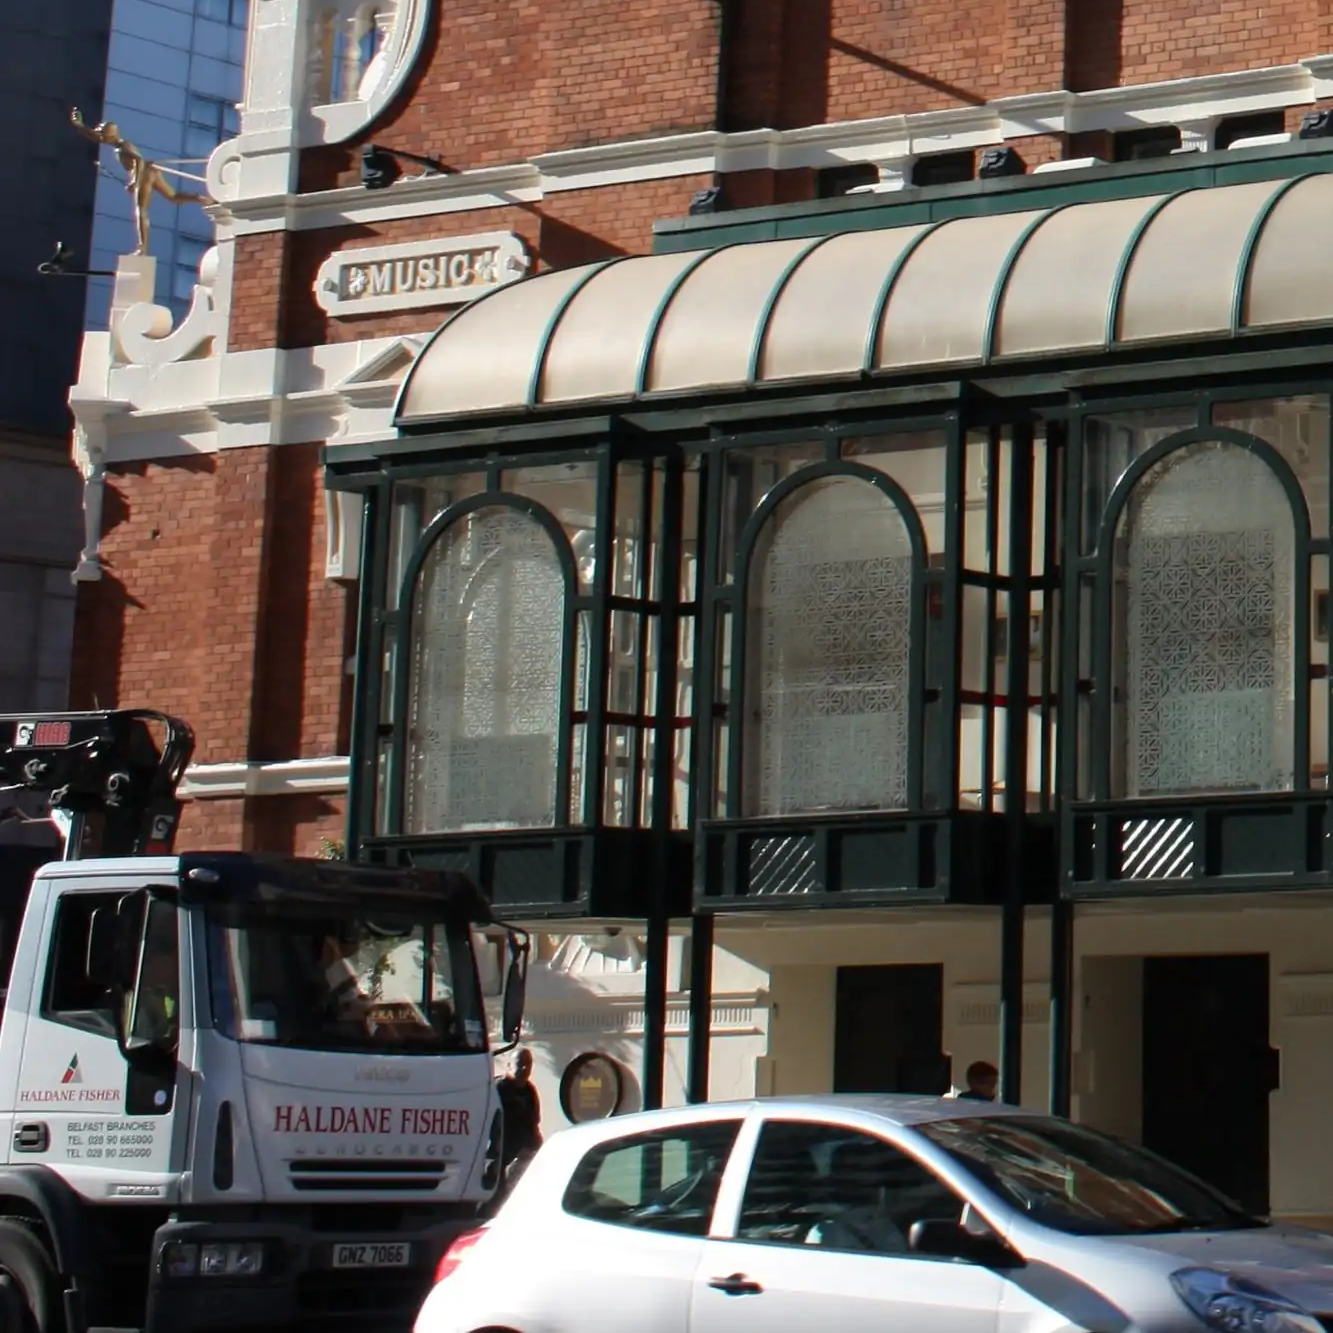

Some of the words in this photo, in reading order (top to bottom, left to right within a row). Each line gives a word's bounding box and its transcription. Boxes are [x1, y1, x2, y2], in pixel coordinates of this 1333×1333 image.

[370, 253, 471, 293] MUSIC
[20, 1089, 75, 1102] HALDANE
[78, 1089, 121, 1102] FISHER
[67, 1122, 104, 1132] BELFAST
[106, 1121, 156, 1132] BRANCHES
[273, 1106, 392, 1134] HALDANE
[400, 1108, 471, 1136] FISHER
[339, 1247, 366, 1264] GNZ
